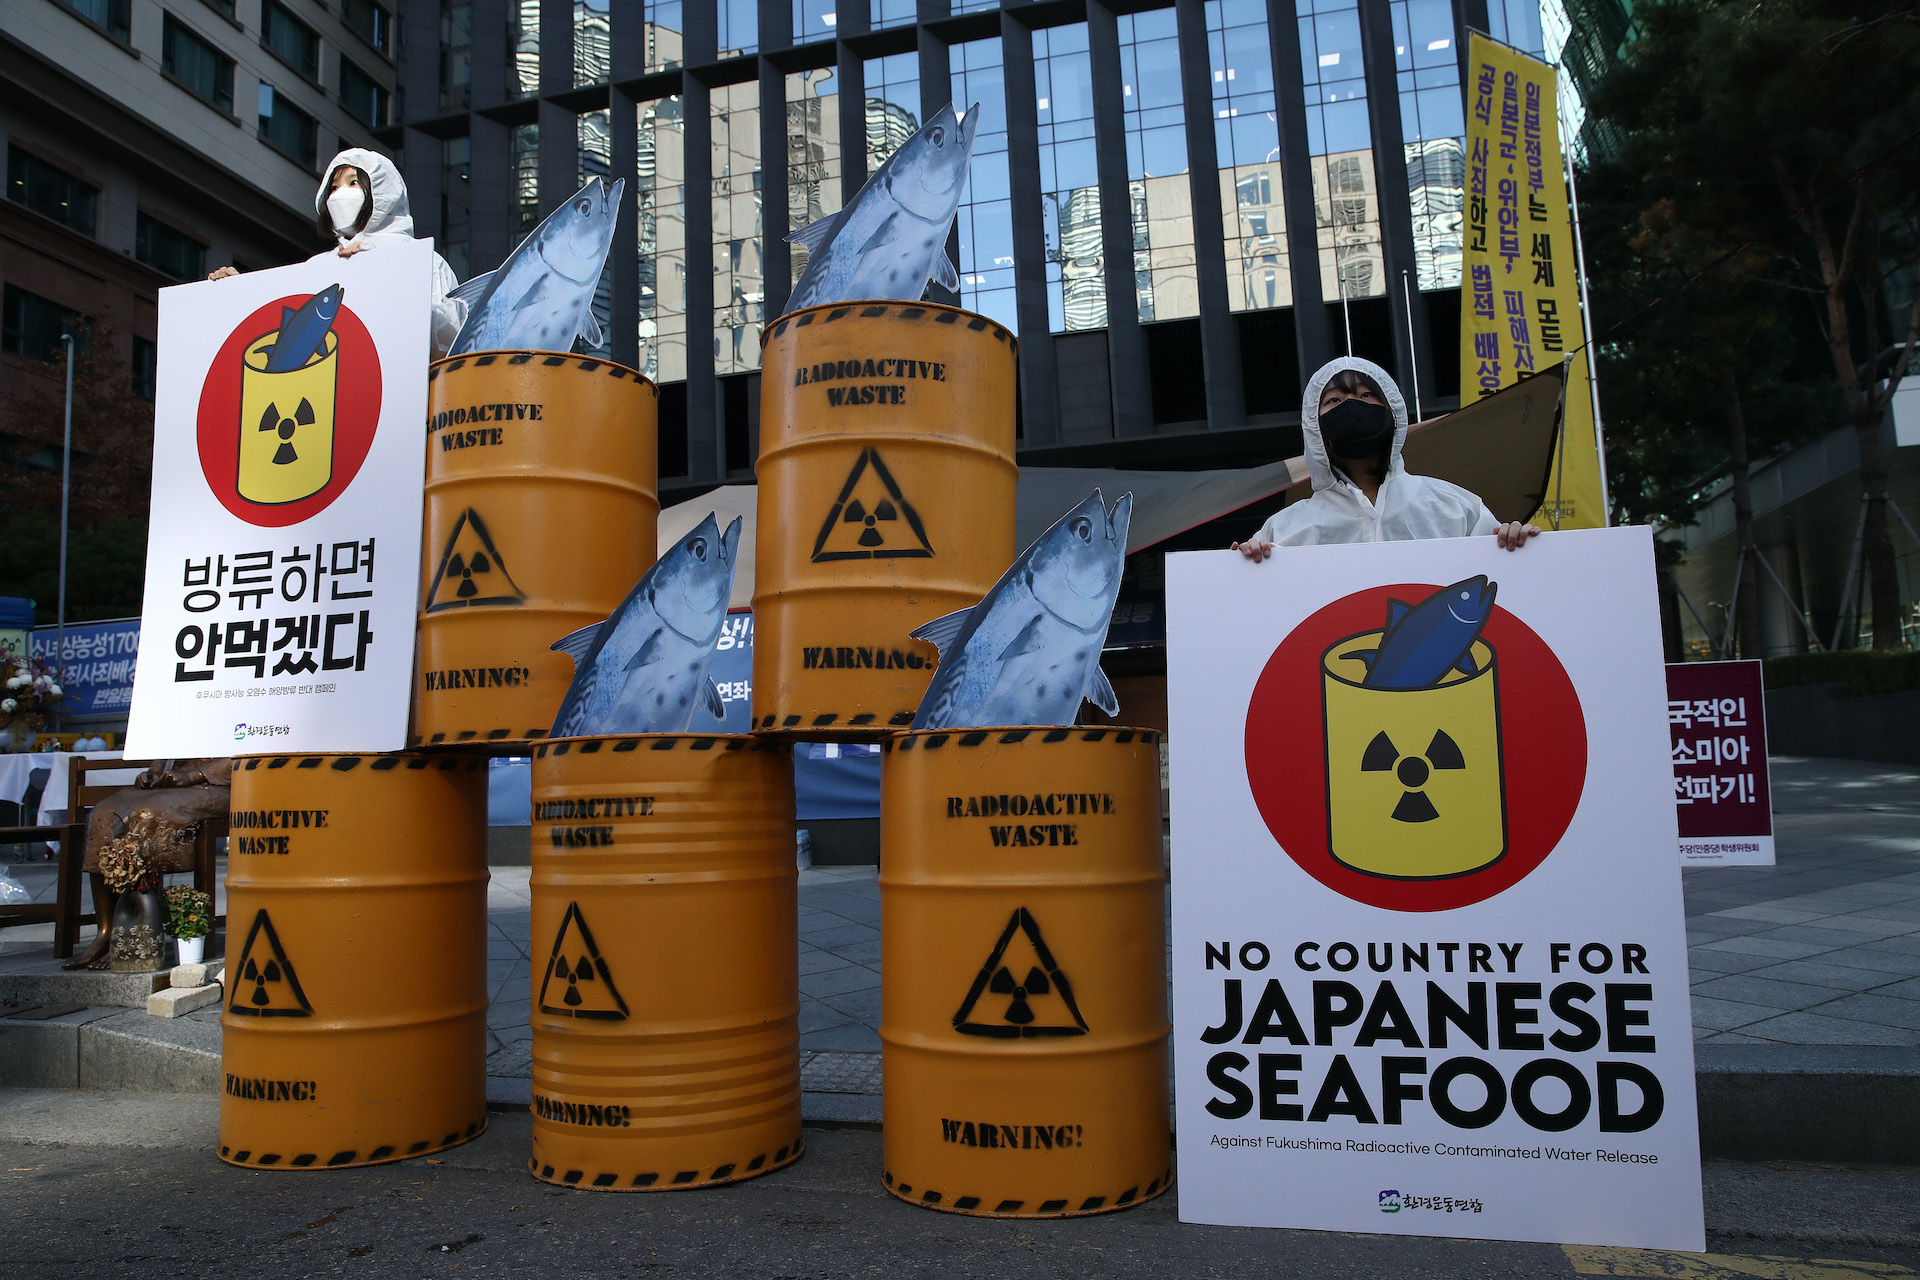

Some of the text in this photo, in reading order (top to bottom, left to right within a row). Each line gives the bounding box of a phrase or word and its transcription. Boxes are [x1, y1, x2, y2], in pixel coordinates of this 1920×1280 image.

[1475, 63, 1495, 126] 공식
[1500, 70, 1519, 161] 일본군
[1470, 136, 1489, 253] 사죄하고
[1524, 81, 1563, 352] 일본정부는 세계 모든
[1471, 264, 1494, 320] 법적
[795, 359, 946, 387] RADIOACTIVE
[827, 385, 906, 407] WASTE
[441, 428, 503, 452] WASTE
[183, 537, 376, 613] 방류하면
[174, 609, 374, 683] 안먹겠다
[803, 646, 932, 670] WARNING!
[196, 683, 337, 700] 후쿠시마 방사능 오염수 해양방류 반대 캠페인
[425, 667, 529, 691] WARNING!
[1672, 735, 1750, 766] 소미아
[534, 796, 655, 821] RADIOACTIVE
[947, 793, 1116, 818] RADIOACTIVE
[239, 836, 289, 854] WASTE
[551, 826, 614, 848] WASTE
[989, 824, 1078, 847] WASTE
[1205, 941, 1650, 974] NO COUNTRY FOR
[1199, 978, 1657, 1053] JAPANESE
[226, 1073, 316, 1101] WARNING!
[1204, 1051, 1665, 1133] SEAFOOD
[536, 1094, 631, 1127] WARNING!
[941, 1118, 1083, 1150] WARNING!
[1210, 1134, 1659, 1165] Against Fukushima Radioactive Contaminated Water Release
[1402, 1193, 1483, 1214] 환경운동연합
